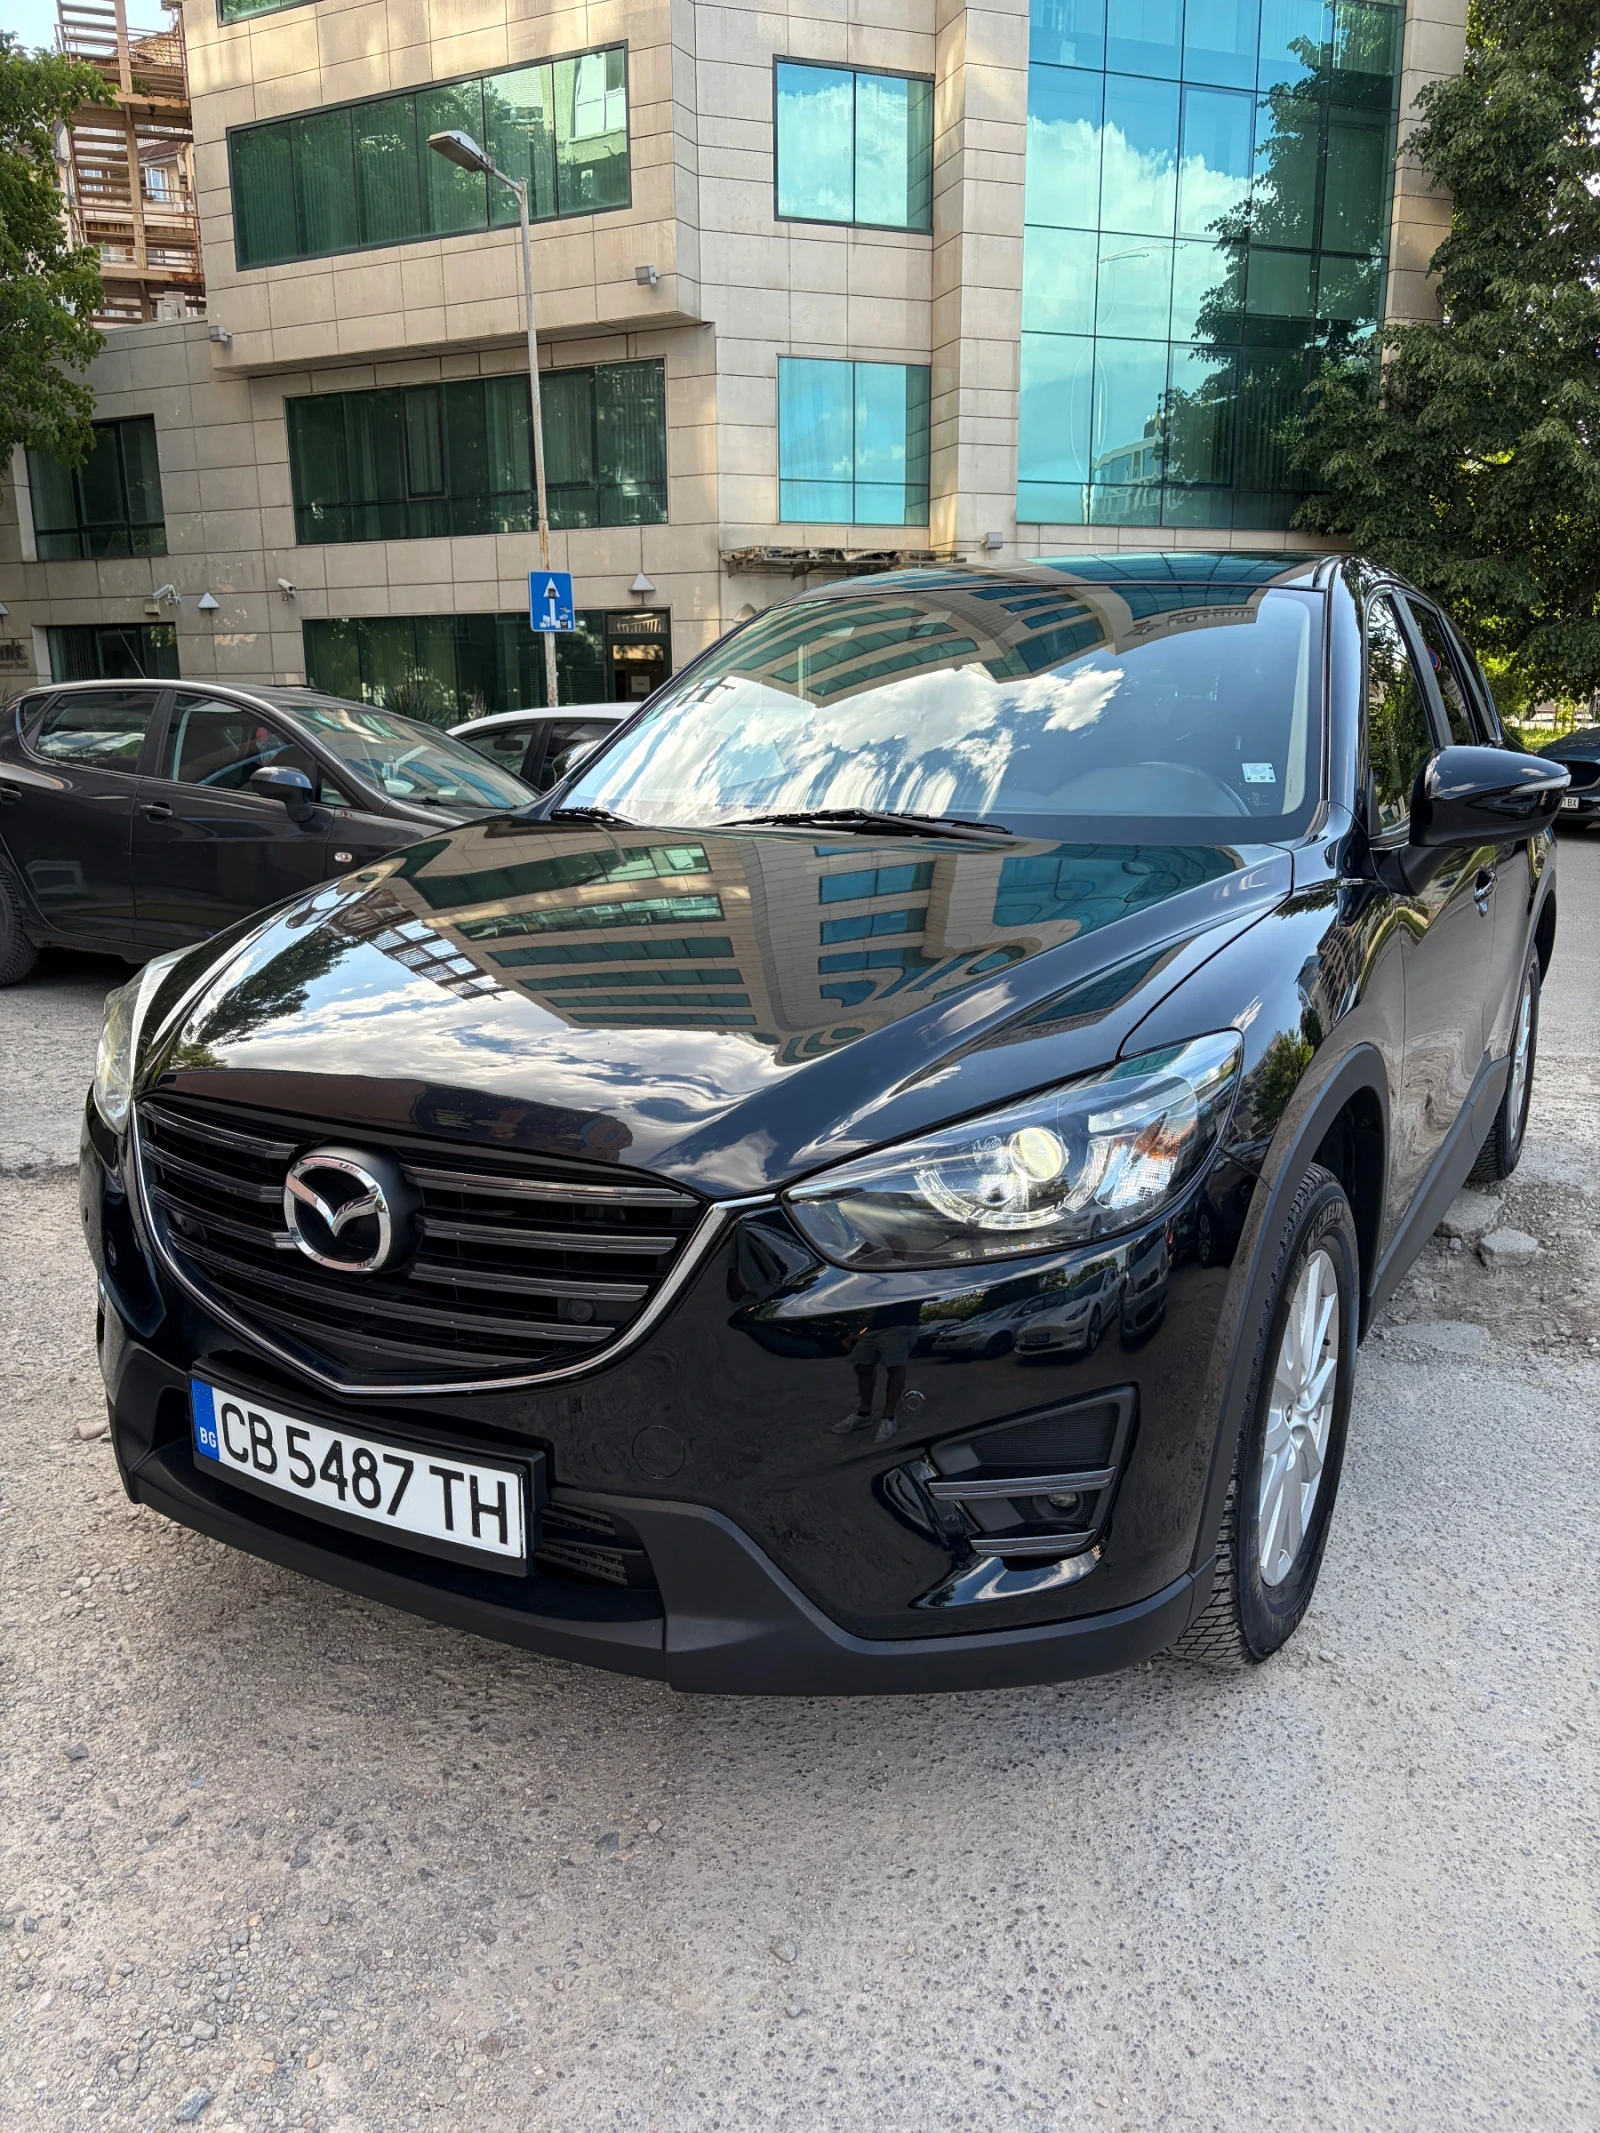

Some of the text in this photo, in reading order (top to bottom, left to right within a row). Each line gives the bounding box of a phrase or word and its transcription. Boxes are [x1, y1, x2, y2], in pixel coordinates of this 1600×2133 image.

[1307, 1202, 1343, 1253] MICHELIN
[200, 1426, 217, 1448] BG
[221, 1402, 508, 1545] CB 5487 TH
